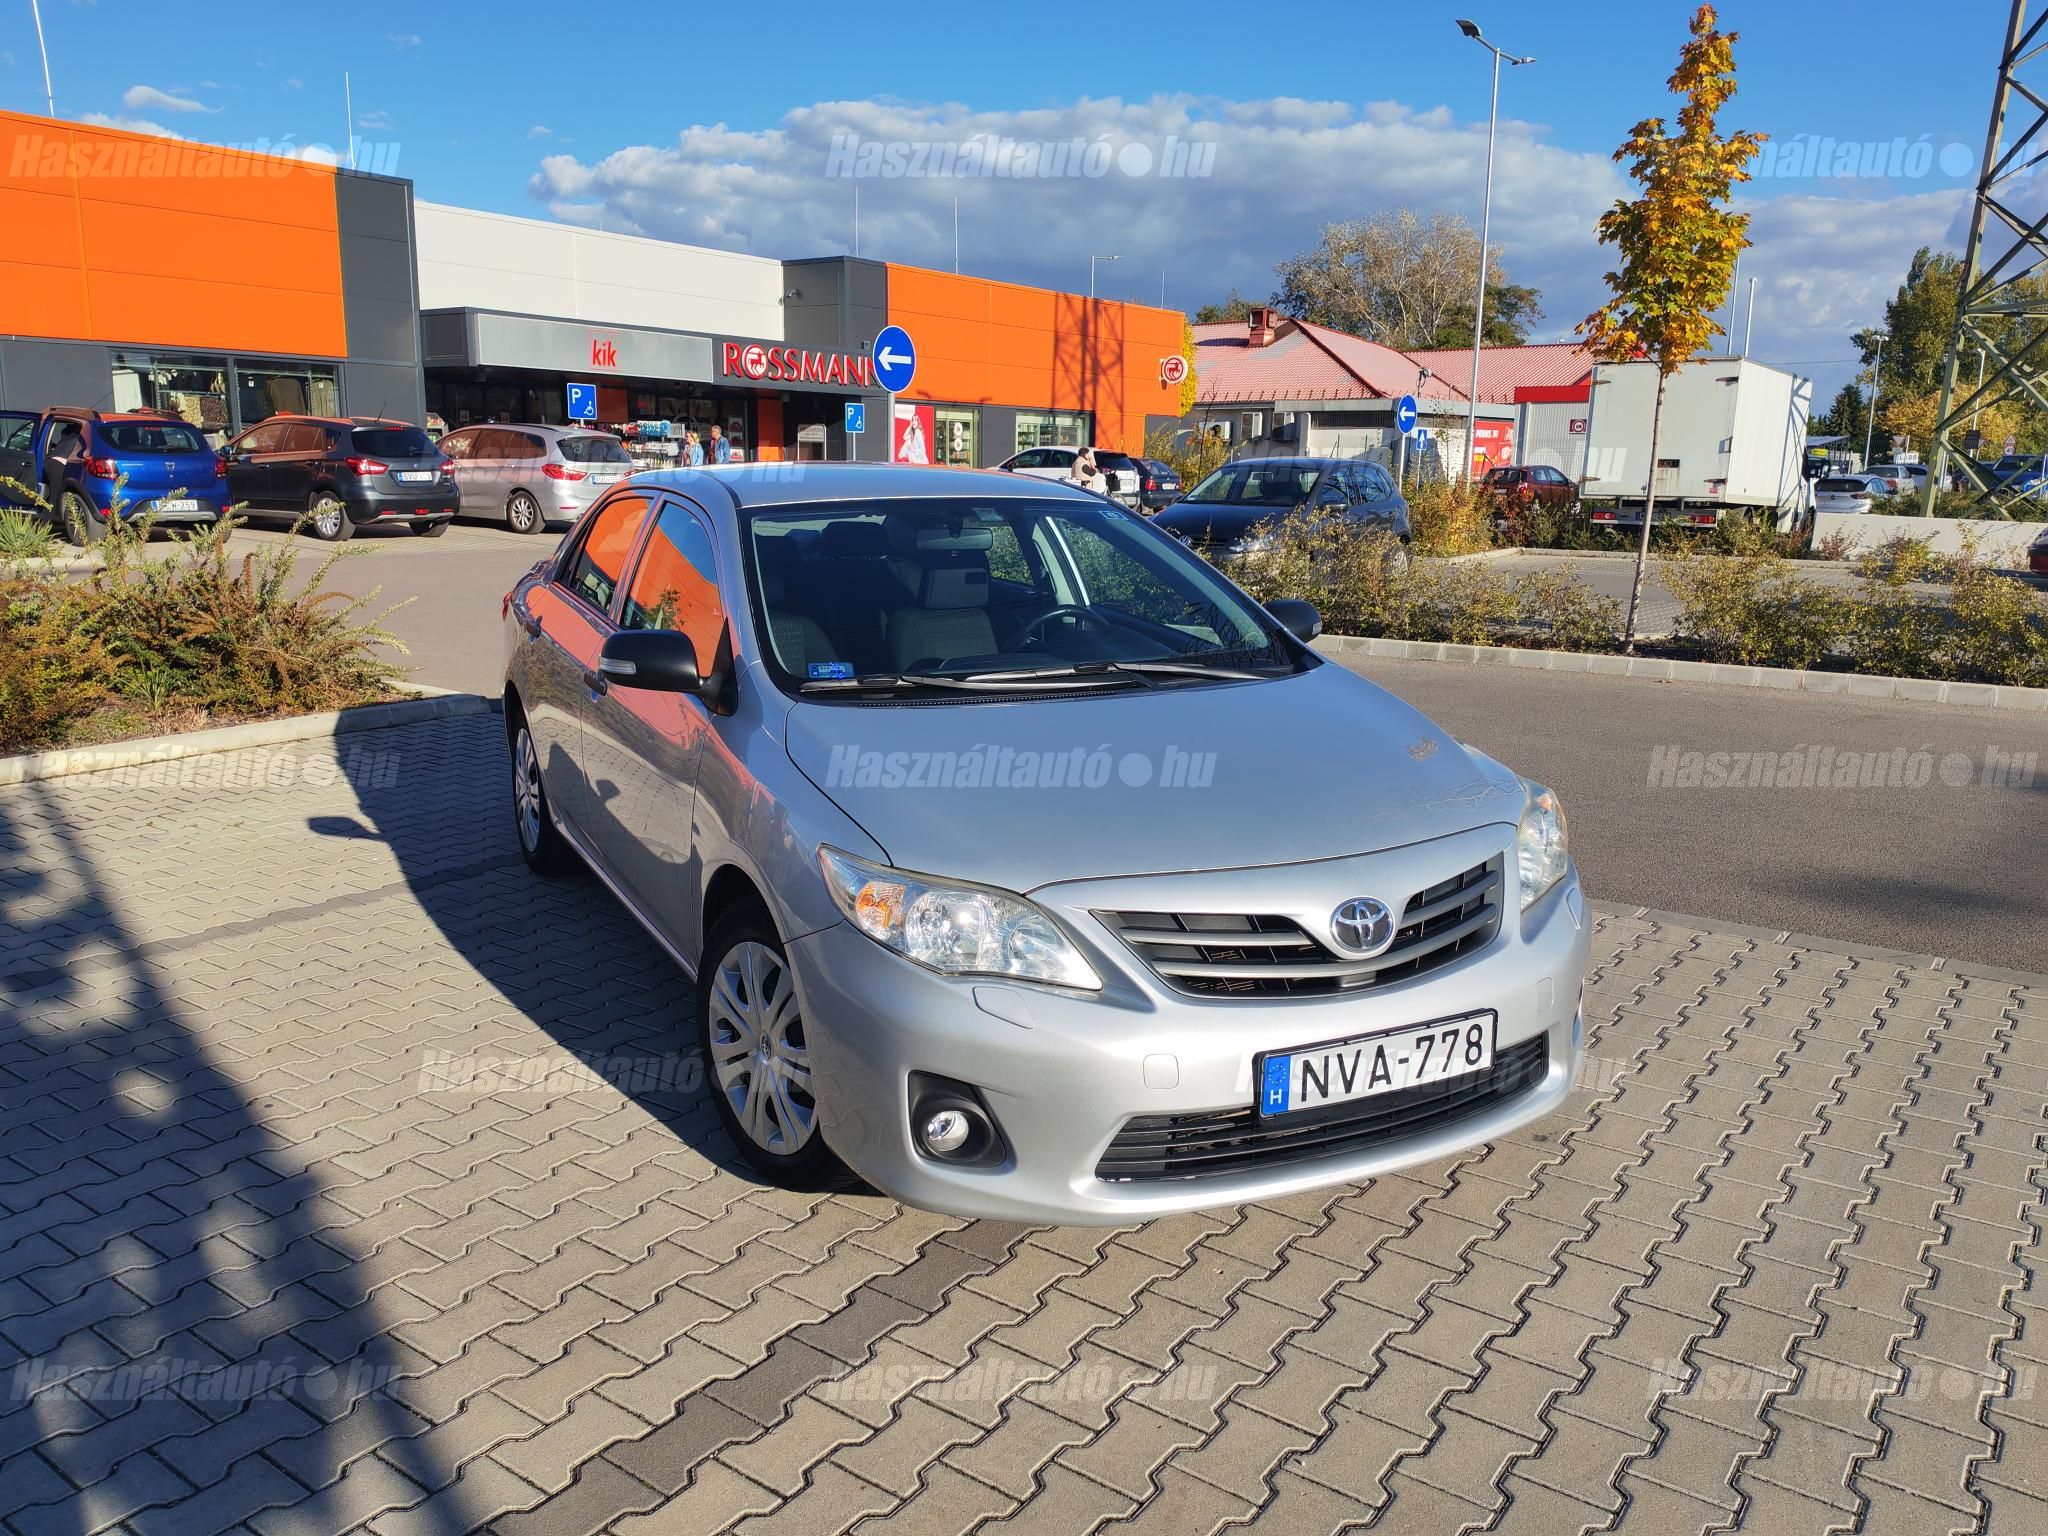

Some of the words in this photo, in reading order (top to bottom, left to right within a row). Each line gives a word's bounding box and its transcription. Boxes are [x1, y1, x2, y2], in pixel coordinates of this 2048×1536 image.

[592, 339, 617, 367] kik
[571, 388, 582, 404] P
[847, 407, 855, 420] P
[1300, 1023, 1483, 1102] NVA-778
[1269, 1089, 1282, 1105] H
